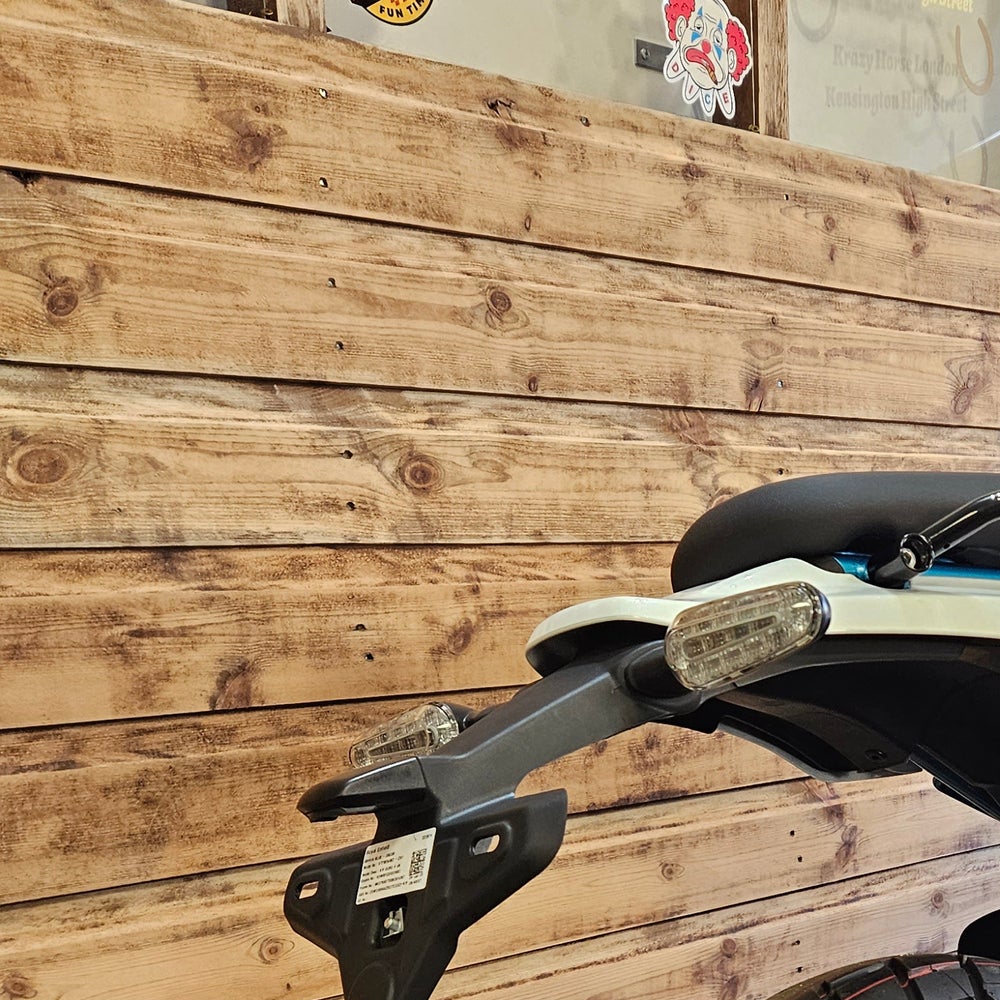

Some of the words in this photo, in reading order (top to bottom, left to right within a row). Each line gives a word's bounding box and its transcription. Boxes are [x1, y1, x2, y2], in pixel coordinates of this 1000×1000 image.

[379, 5, 404, 18] FUN
[832, 44, 873, 73] Krazy
[875, 48, 912, 74] Horse
[914, 54, 960, 77] London
[671, 62, 728, 104] DICE
[824, 84, 899, 116] Kensington
[901, 89, 933, 116] High
[932, 91, 967, 113] Street
